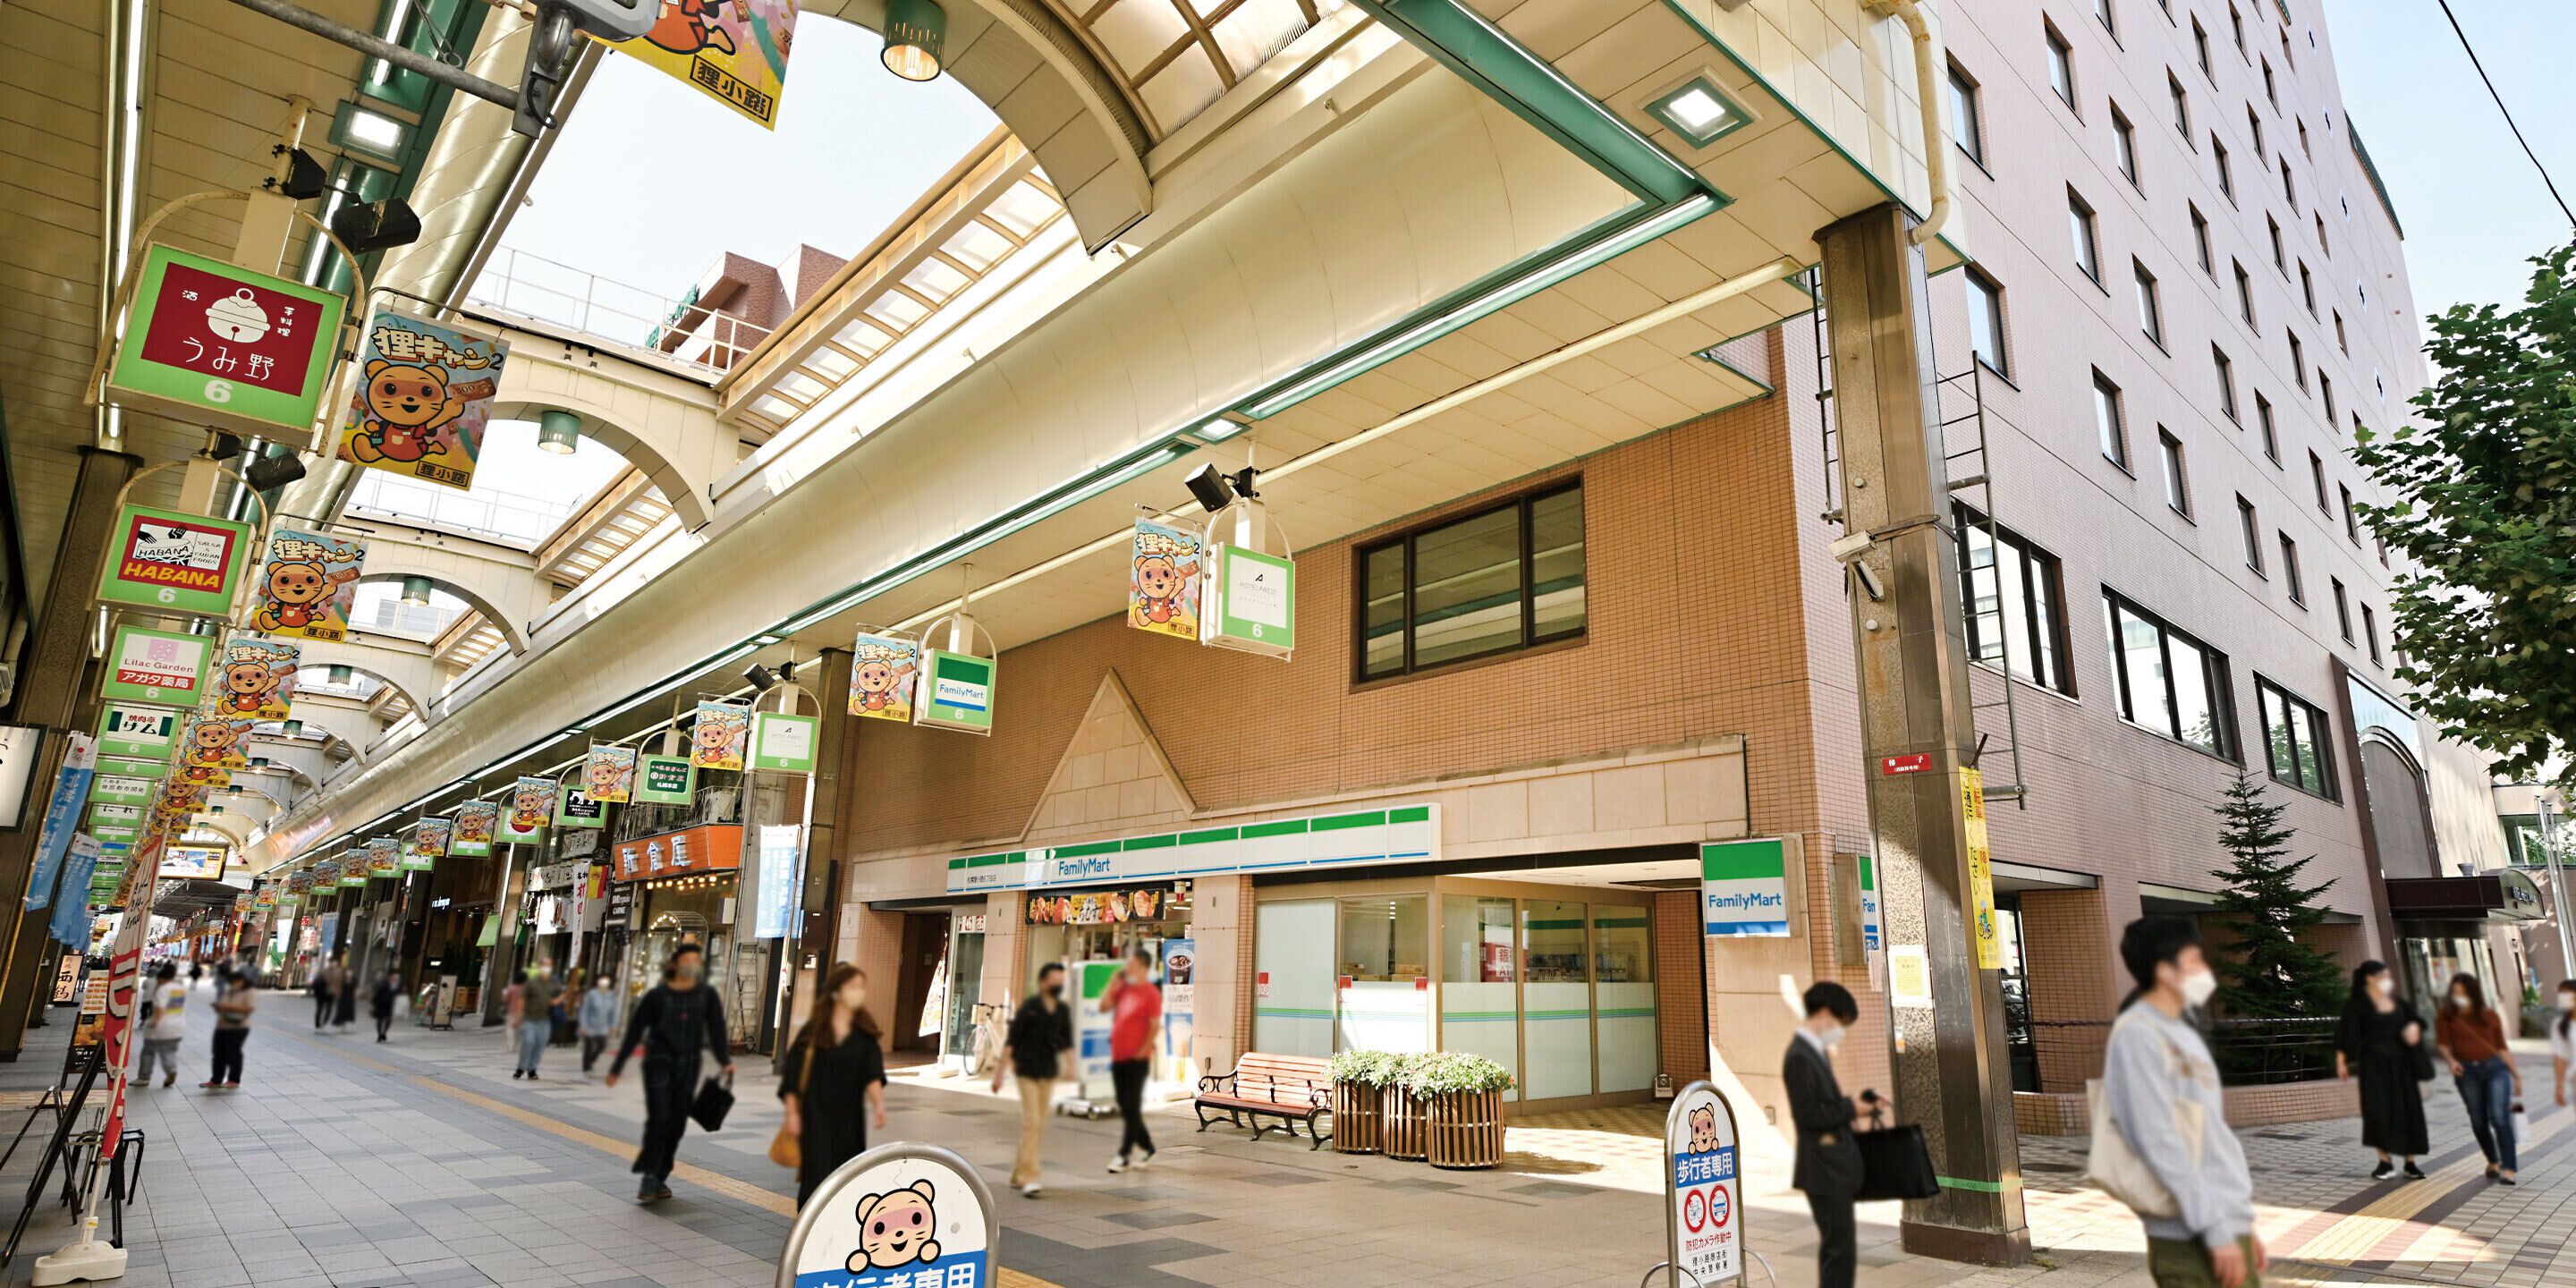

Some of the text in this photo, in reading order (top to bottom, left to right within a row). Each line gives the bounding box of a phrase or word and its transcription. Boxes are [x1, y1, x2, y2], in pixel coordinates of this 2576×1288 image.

[697, 61, 767, 115] 狸小路
[182, 290, 199, 301] 酒
[276, 306, 295, 337] 手料理
[182, 336, 275, 380] うみ野
[204, 379, 233, 403] 6
[419, 462, 466, 485] 狸小路
[139, 545, 189, 557] HABANA
[198, 540, 221, 548] SALSA
[192, 557, 218, 565] FOODS
[194, 551, 220, 560] CUBAN
[123, 562, 220, 589] HABANA
[157, 588, 177, 604] 6
[307, 627, 340, 640] 狸小路
[1252, 623, 1263, 638] 6
[124, 657, 194, 673] Lilac Garden
[122, 671, 189, 689] アガタ薬局
[145, 686, 160, 699] 6
[939, 683, 984, 699] FamilyMart
[128, 714, 156, 724] 焼肉亭
[954, 708, 965, 720] 6
[122, 721, 157, 735] サム
[128, 743, 140, 754] 6
[126, 764, 137, 773] 6
[779, 758, 788, 767] 6
[115, 793, 124, 802] 6
[1058, 857, 1111, 878] FamilyMart
[1708, 893, 1783, 911] FamilyMart
[1677, 1151, 1733, 1185] 歩行者専用
[1685, 1231, 1732, 1252] 防犯カメラ作動中
[1692, 1249, 1727, 1267] 狸小路商店街
[1692, 1259, 1728, 1275] 中央警察署
